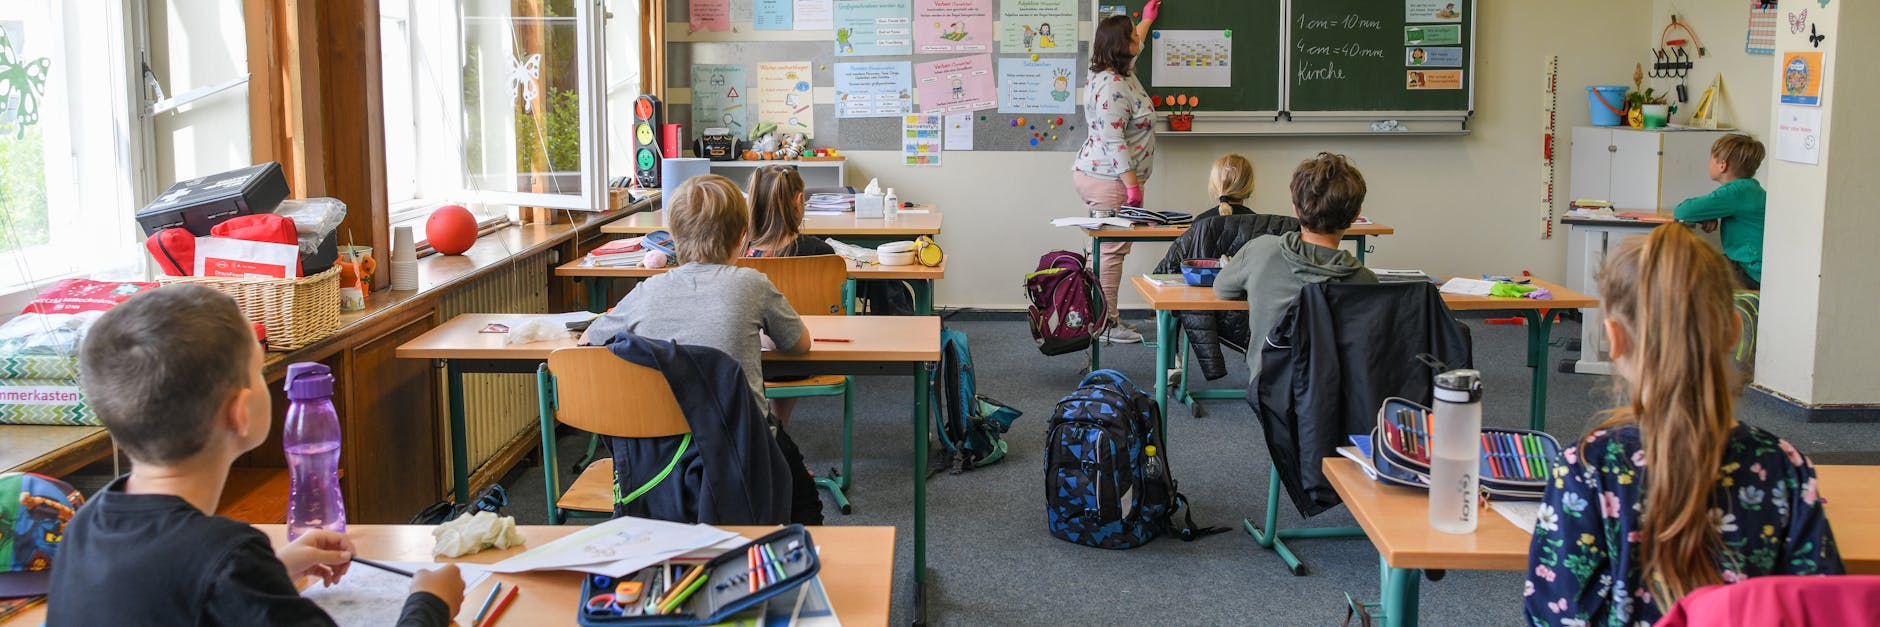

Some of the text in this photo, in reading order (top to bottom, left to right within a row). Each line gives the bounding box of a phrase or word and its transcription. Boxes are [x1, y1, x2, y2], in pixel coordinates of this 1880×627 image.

[1296, 13, 1304, 30] 1
[1342, 14, 1359, 29] 10
[1296, 38, 1304, 52] 4
[1297, 59, 1346, 86] Kirche
